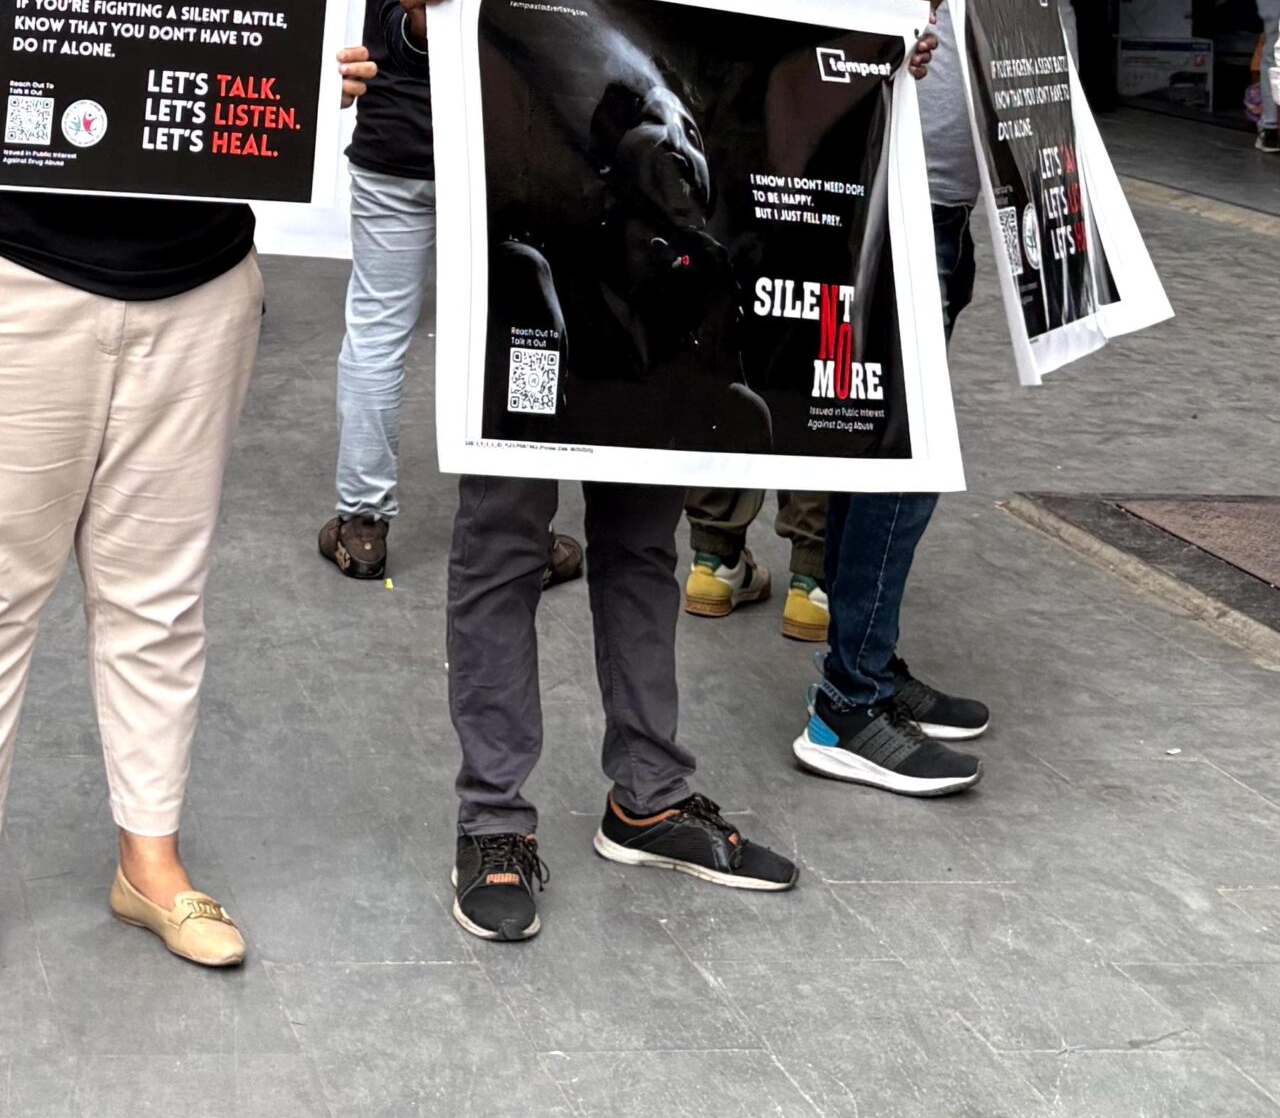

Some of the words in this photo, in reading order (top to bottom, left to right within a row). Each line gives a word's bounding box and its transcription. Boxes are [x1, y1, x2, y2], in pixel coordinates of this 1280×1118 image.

[94, 0, 162, 19] FIGHTING
[166, 6, 177, 20] A
[181, 6, 229, 23] SILENT
[233, 11, 288, 29] BATTLE,
[14, 16, 65, 33] KNOW
[69, 20, 106, 36] THAT
[111, 23, 146, 39] YOU
[149, 26, 198, 42] DON'T
[200, 29, 237, 45] HAVE
[241, 31, 262, 47] TO
[12, 38, 36, 51] DO
[42, 39, 57, 53] IT
[60, 41, 116, 58] ALONE.
[216, 74, 281, 100] TALK.
[213, 103, 301, 130] LISTEN.
[211, 131, 279, 157] HEAL.
[752, 189, 765, 202] TO
[767, 191, 779, 204] BE
[755, 206, 772, 220] BUT
[780, 209, 801, 222] JUST
[753, 276, 855, 359] SILENT
[811, 322, 884, 400] MORE
